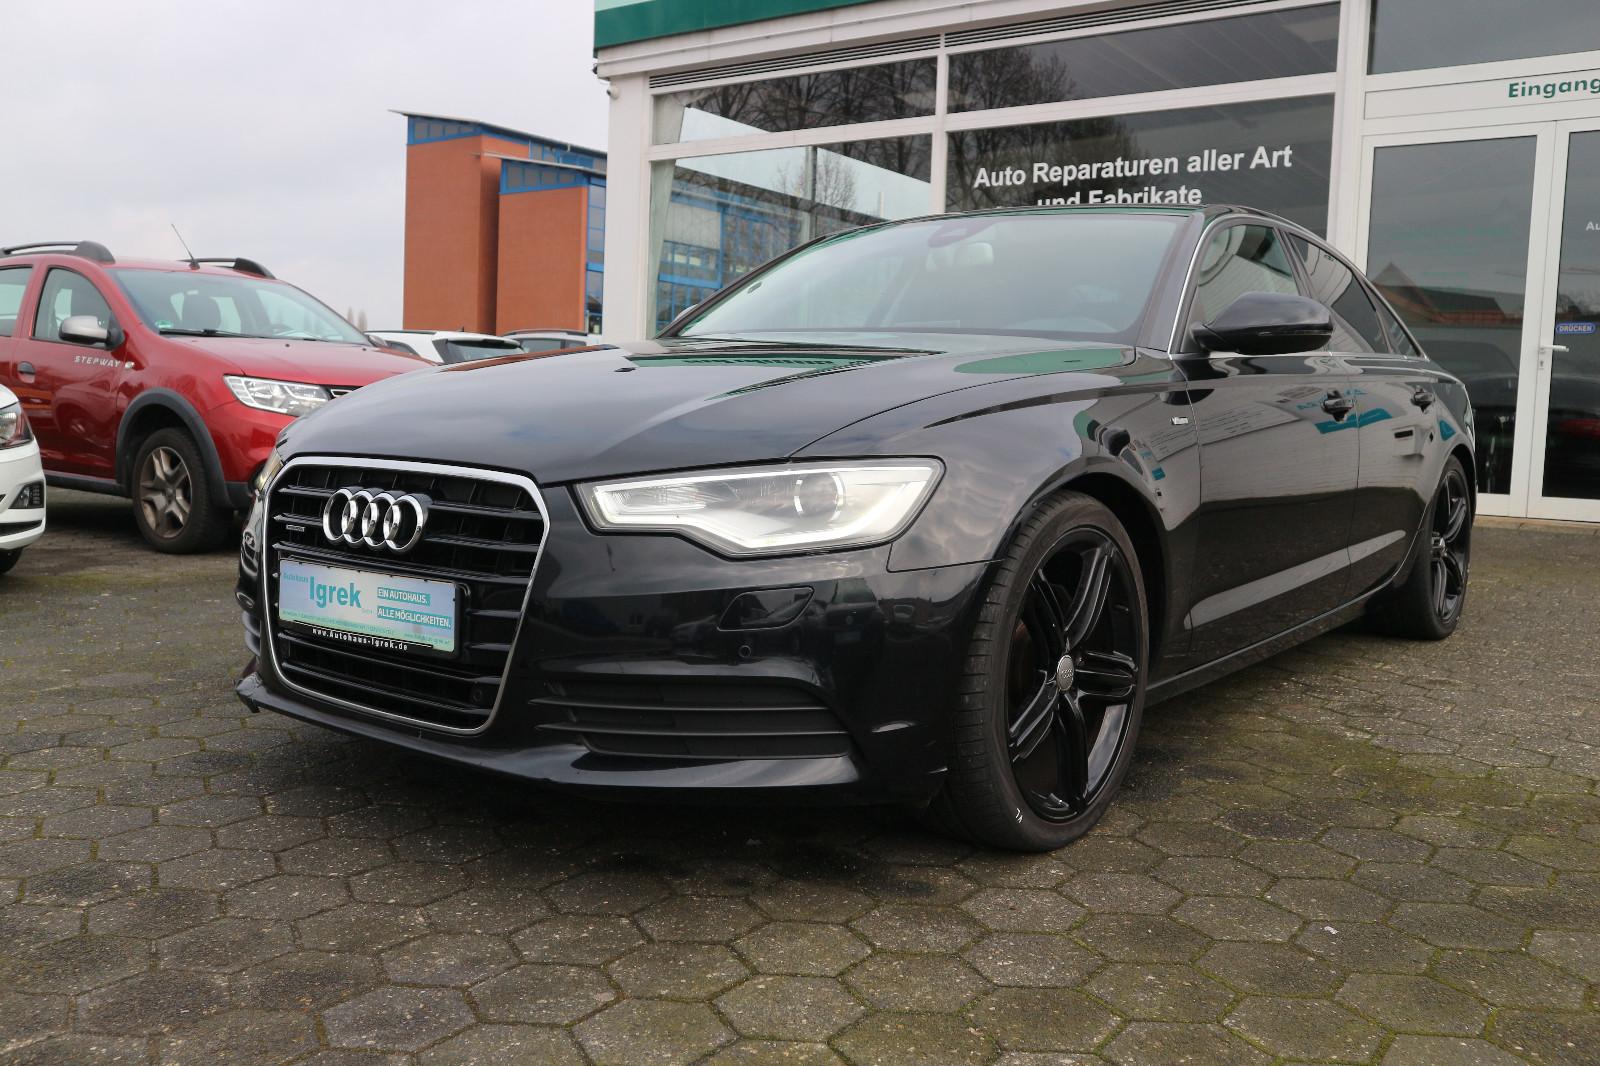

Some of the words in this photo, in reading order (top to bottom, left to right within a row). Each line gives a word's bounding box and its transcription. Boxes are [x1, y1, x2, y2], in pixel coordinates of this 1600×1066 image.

[1508, 78, 1600, 98] Eingang
[973, 166, 1026, 188] Auto
[1032, 156, 1178, 186] Reparaturen
[1186, 149, 1245, 172] aller
[1249, 145, 1293, 169] Art
[1088, 185, 1203, 205] Fabrikate
[74, 355, 121, 368] STEPWAY
[309, 575, 362, 609] Igrek
[378, 588, 389, 597] EIN
[390, 590, 428, 604] AUTOHAUS.
[378, 607, 394, 618] ALLE
[394, 608, 451, 628] MÖGLICHKEITEN.
